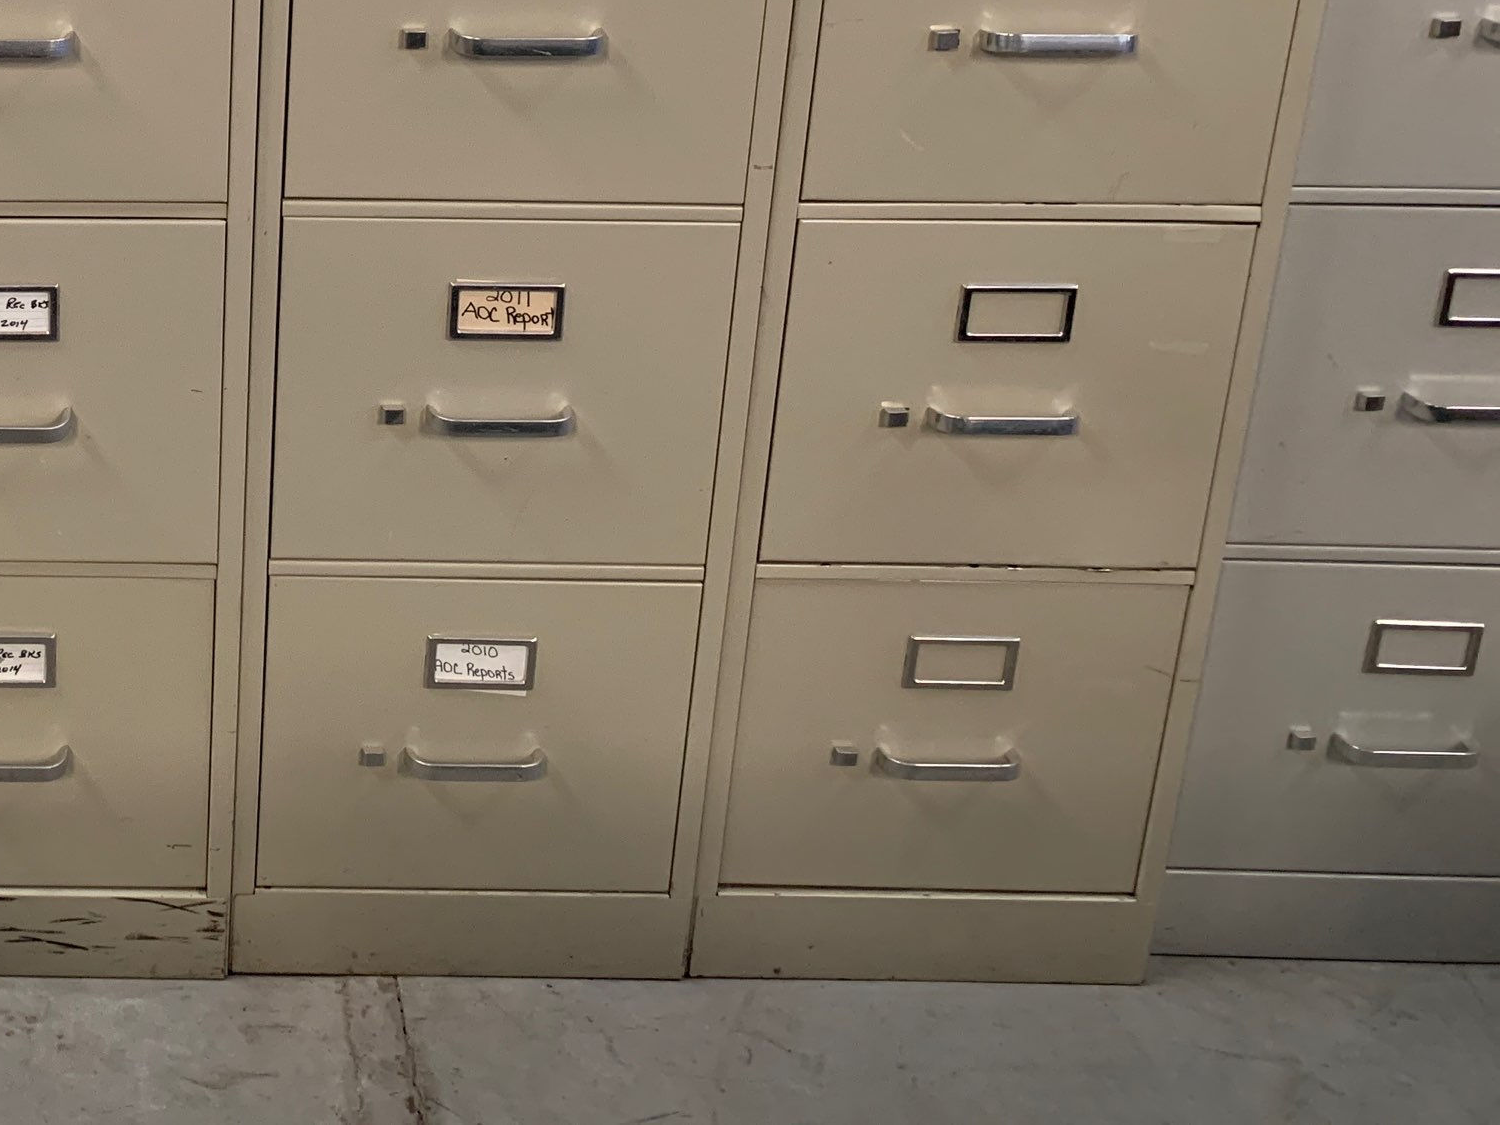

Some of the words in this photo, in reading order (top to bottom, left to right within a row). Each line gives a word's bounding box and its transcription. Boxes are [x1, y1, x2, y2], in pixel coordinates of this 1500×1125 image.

[461, 302, 499, 322] AOC
[461, 644, 499, 658] 2010
[435, 659, 462, 675] AOC
